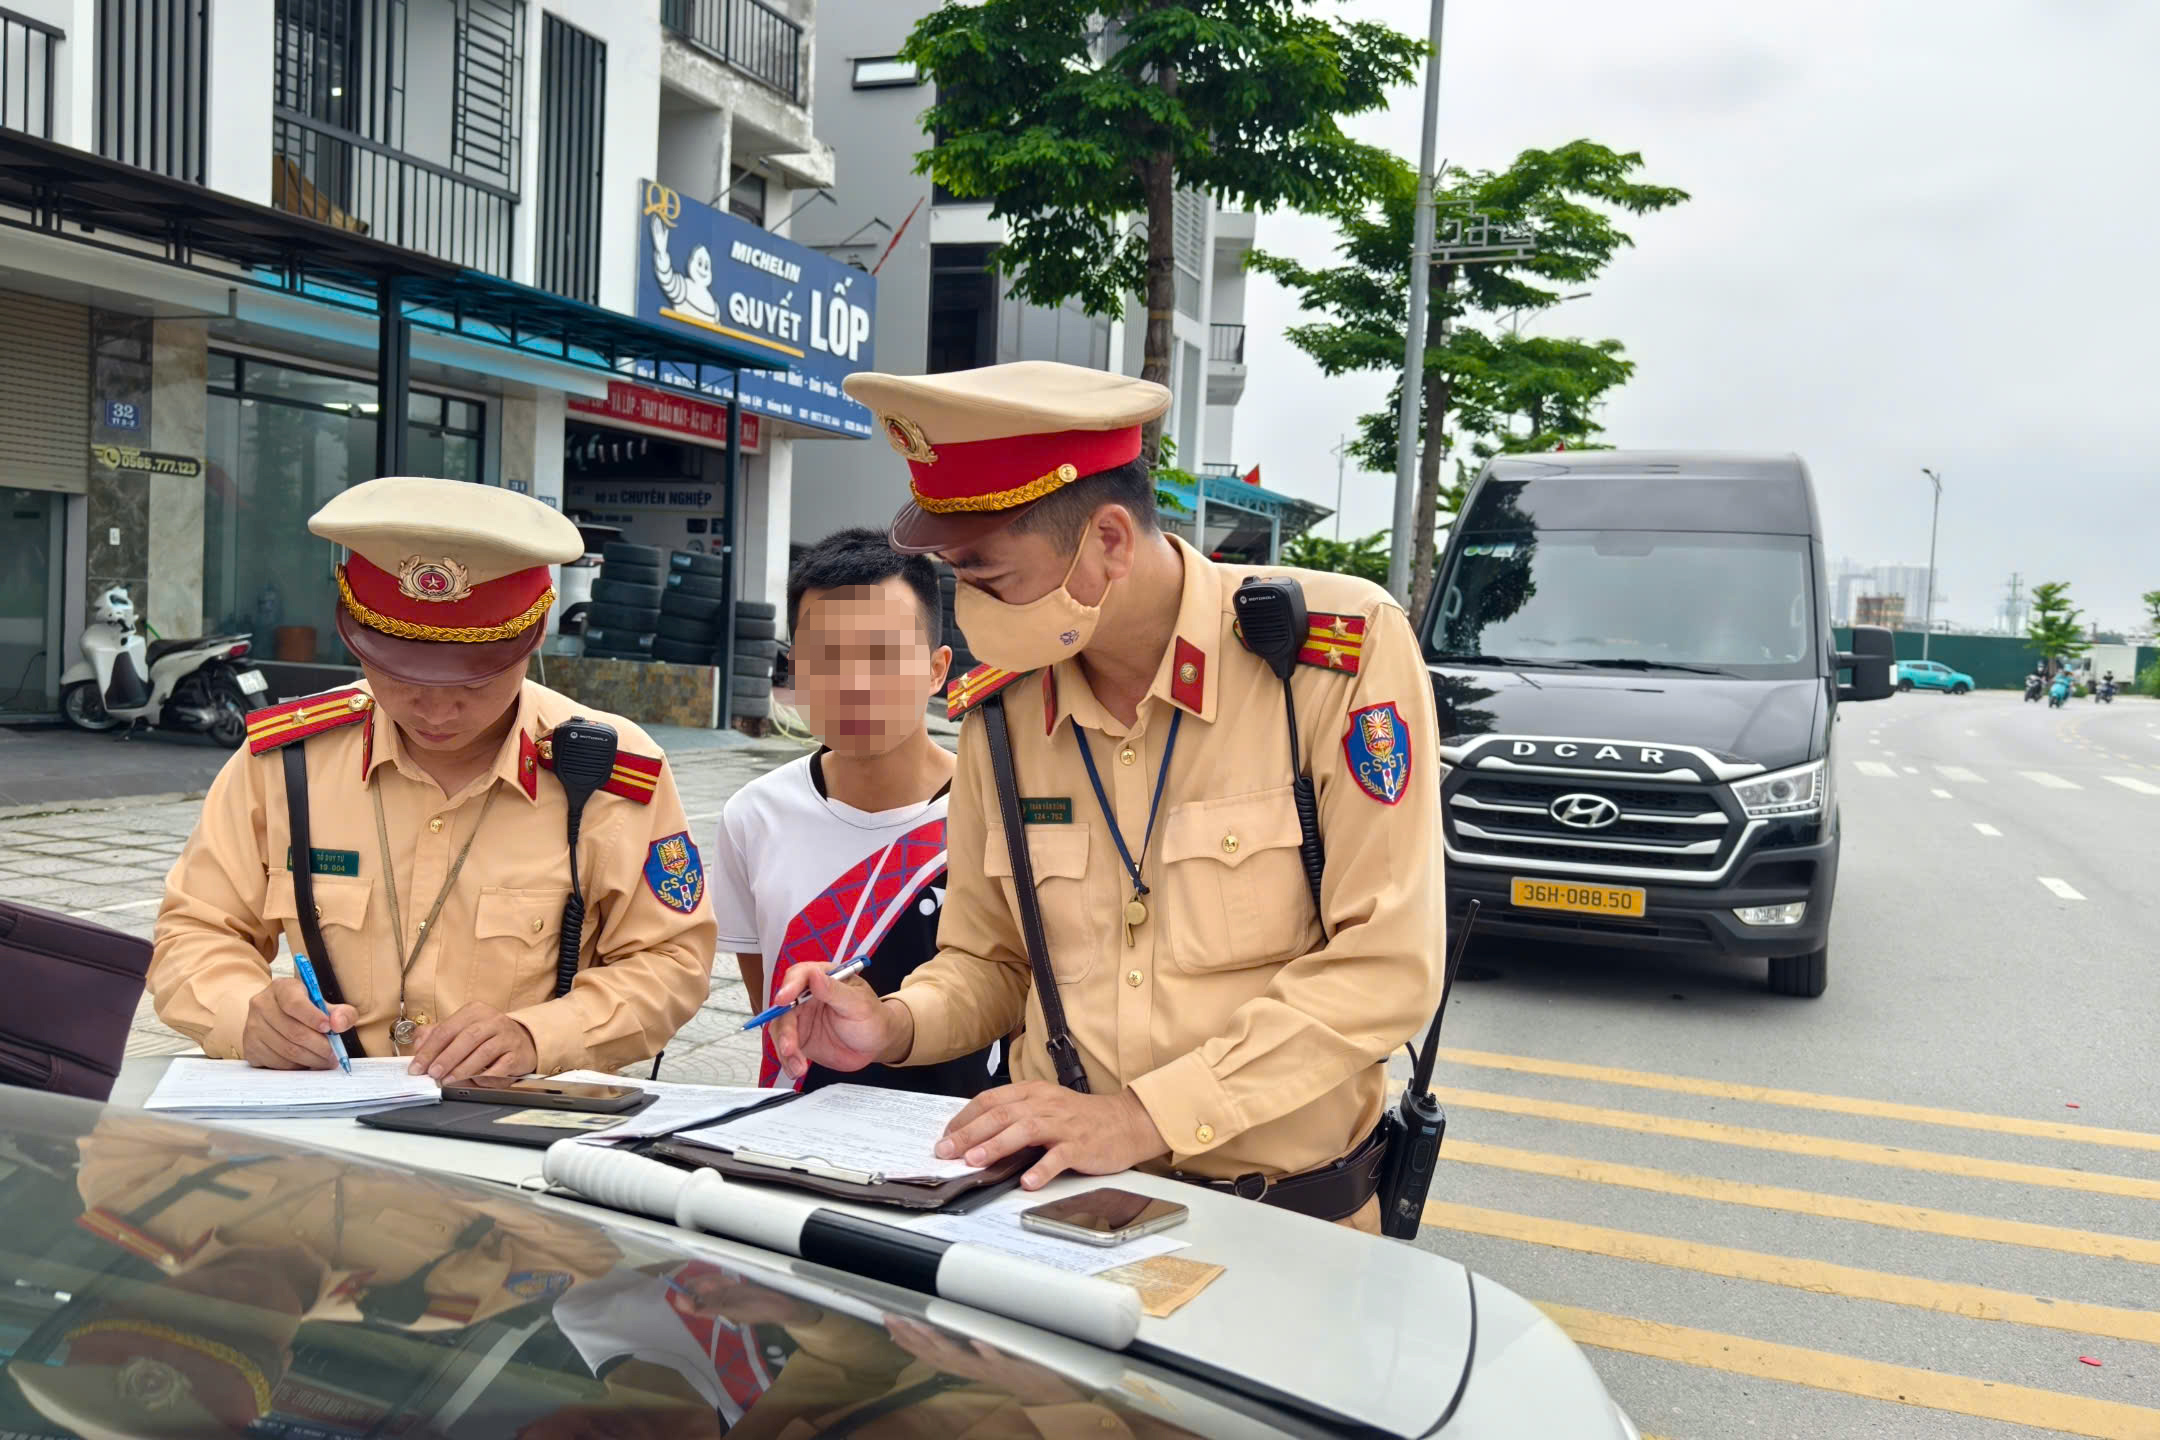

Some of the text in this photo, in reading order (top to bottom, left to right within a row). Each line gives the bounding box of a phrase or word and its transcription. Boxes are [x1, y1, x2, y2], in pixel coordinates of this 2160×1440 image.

[731, 240, 801, 283] MICHELIN
[729, 276, 870, 362] QUYẾT LỐP
[113, 403, 134, 419] 32
[620, 488, 665, 505] CHUYÊN
[669, 489, 713, 508] NGHIỆP
[1522, 884, 1633, 911] 36H-088.50
